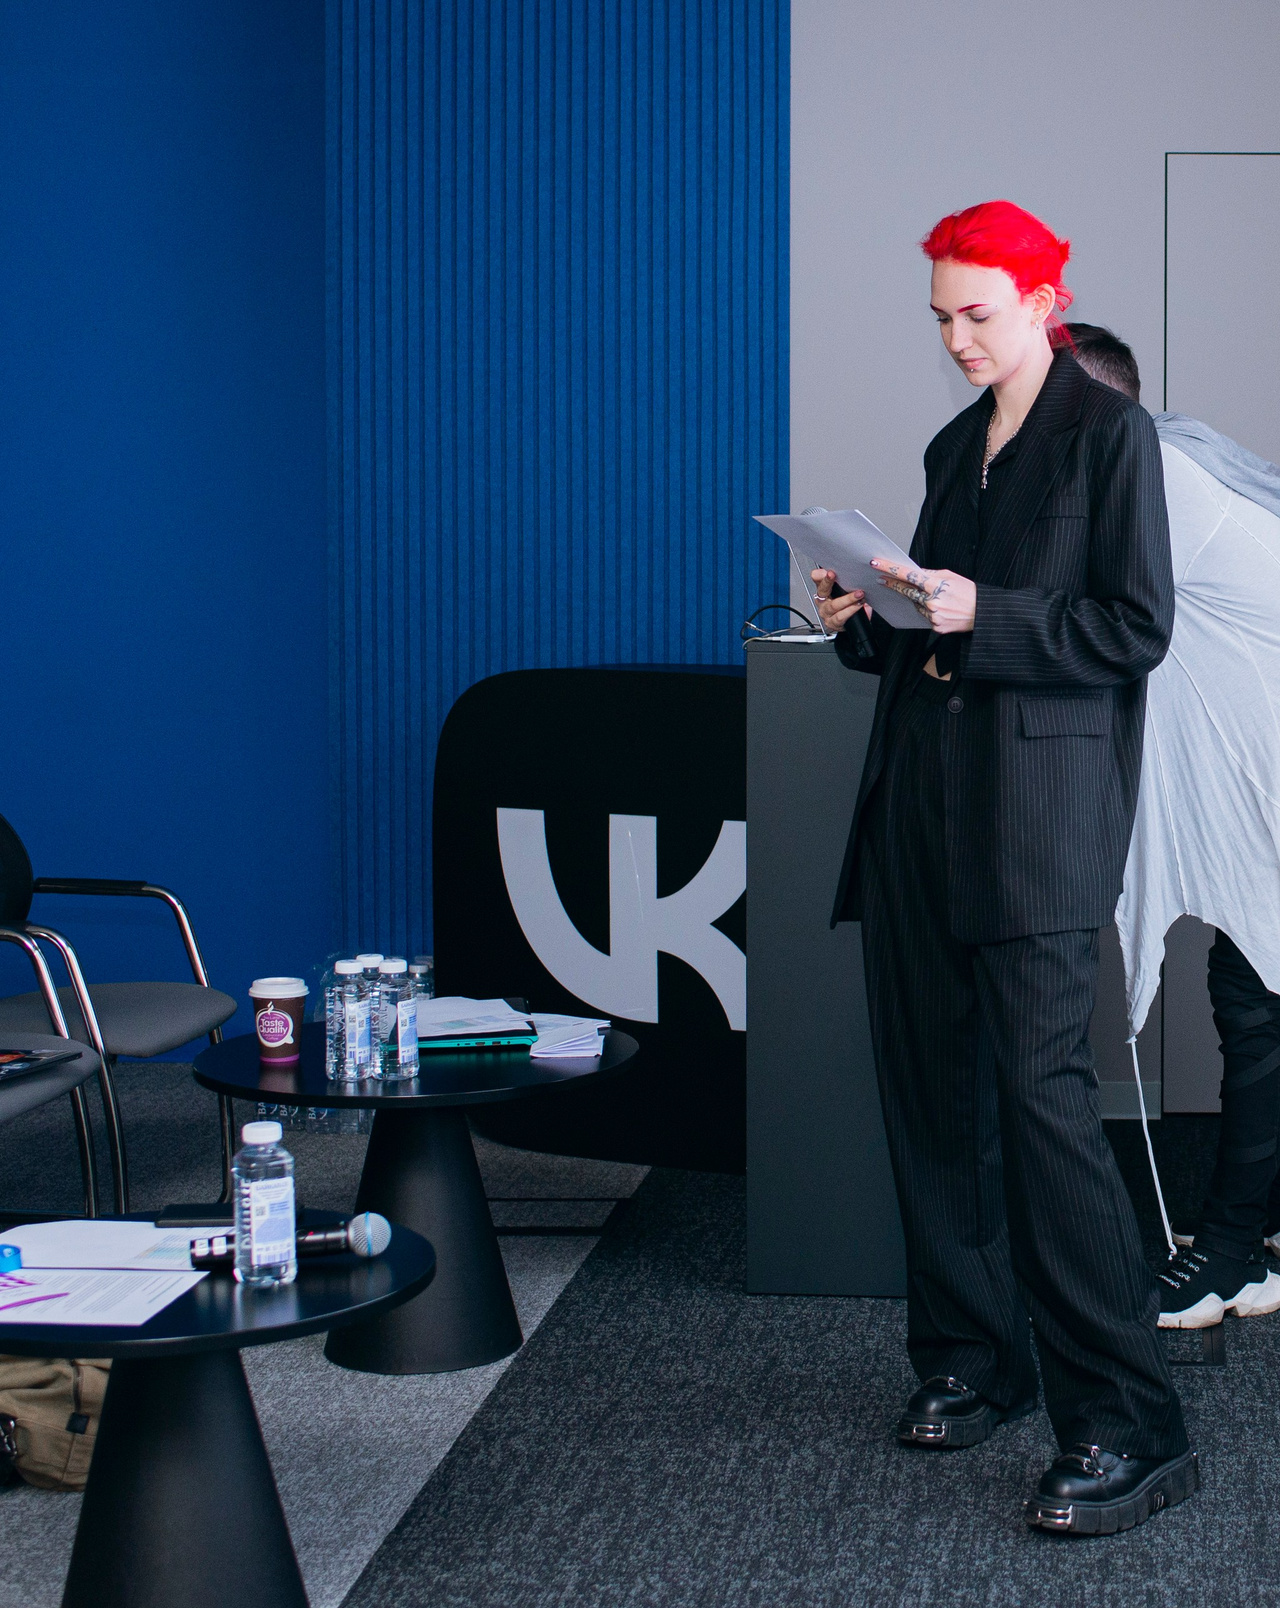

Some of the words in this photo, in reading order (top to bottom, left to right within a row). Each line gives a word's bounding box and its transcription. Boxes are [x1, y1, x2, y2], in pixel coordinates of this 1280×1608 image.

[496, 807, 746, 1031] VK
[260, 1019, 284, 1027] Taste
[259, 1025, 288, 1034] Quality
